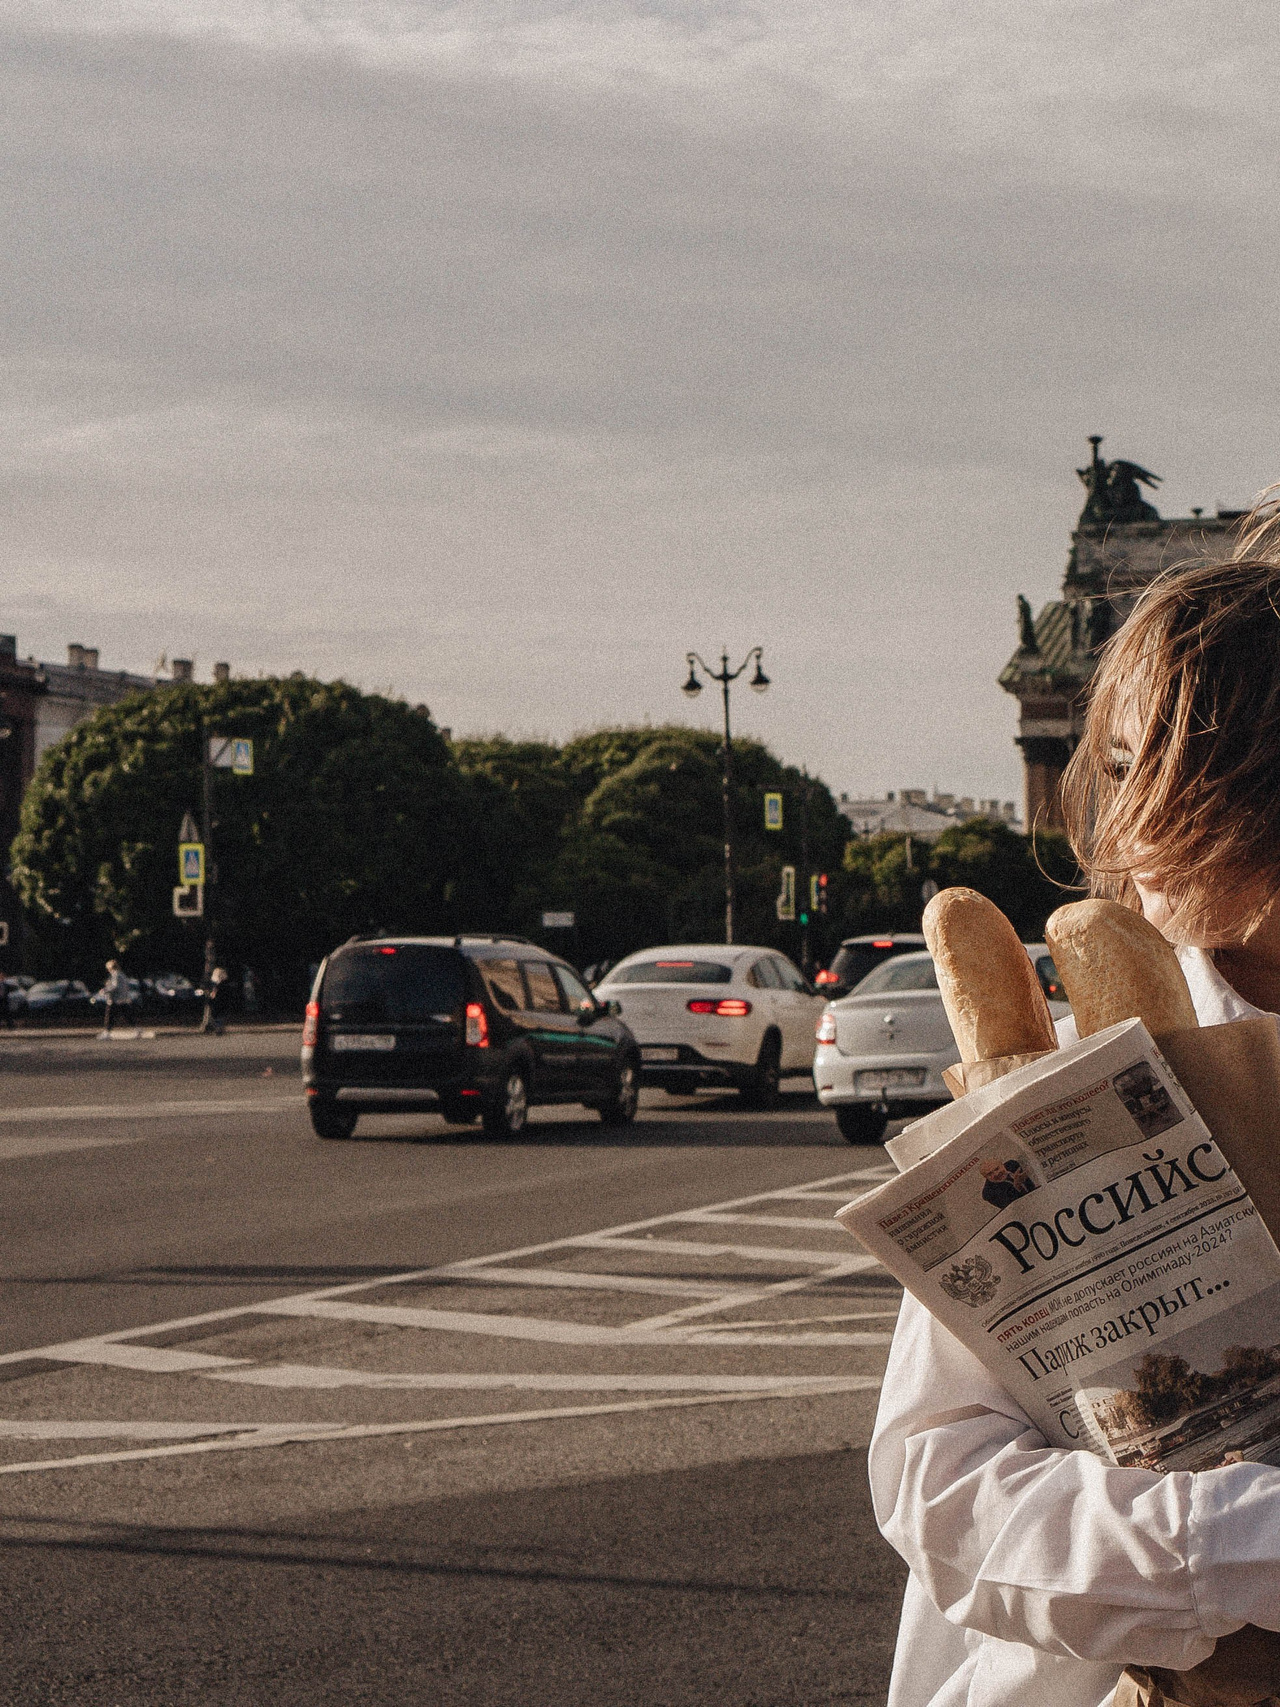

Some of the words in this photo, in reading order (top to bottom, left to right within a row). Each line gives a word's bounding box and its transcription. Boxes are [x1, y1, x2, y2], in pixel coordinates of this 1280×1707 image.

[1073, 1080, 1109, 1104] колесо?
[1019, 1120, 1052, 1139] Плюсы
[1028, 1118, 1091, 1147] общественного
[1035, 1131, 1085, 1157] транспорта
[1048, 1140, 1089, 1168] регионах
[879, 1209, 909, 1230] Павел
[988, 1137, 1232, 1275] Российс
[1169, 1204, 1199, 1224] сентября
[888, 1207, 932, 1238] напомнил
[904, 1211, 945, 1241] гаражной
[905, 1224, 948, 1254] амнистии
[996, 1324, 1023, 1343] ПЯТЬ
[1022, 1307, 1050, 1328] КОЛЕЦ
[1062, 1295, 1073, 1307] не
[1073, 1268, 1126, 1304] допускает
[1128, 1241, 1181, 1275] россиян
[1183, 1233, 1198, 1248] на
[1006, 1328, 1041, 1354] нашим
[1068, 1296, 1106, 1320] попасть
[1106, 1288, 1121, 1300] на
[1121, 1228, 1233, 1293] Олимпиаду-2024?
[1016, 1333, 1093, 1382] Париж
[1090, 1276, 1230, 1349] закрыт...
